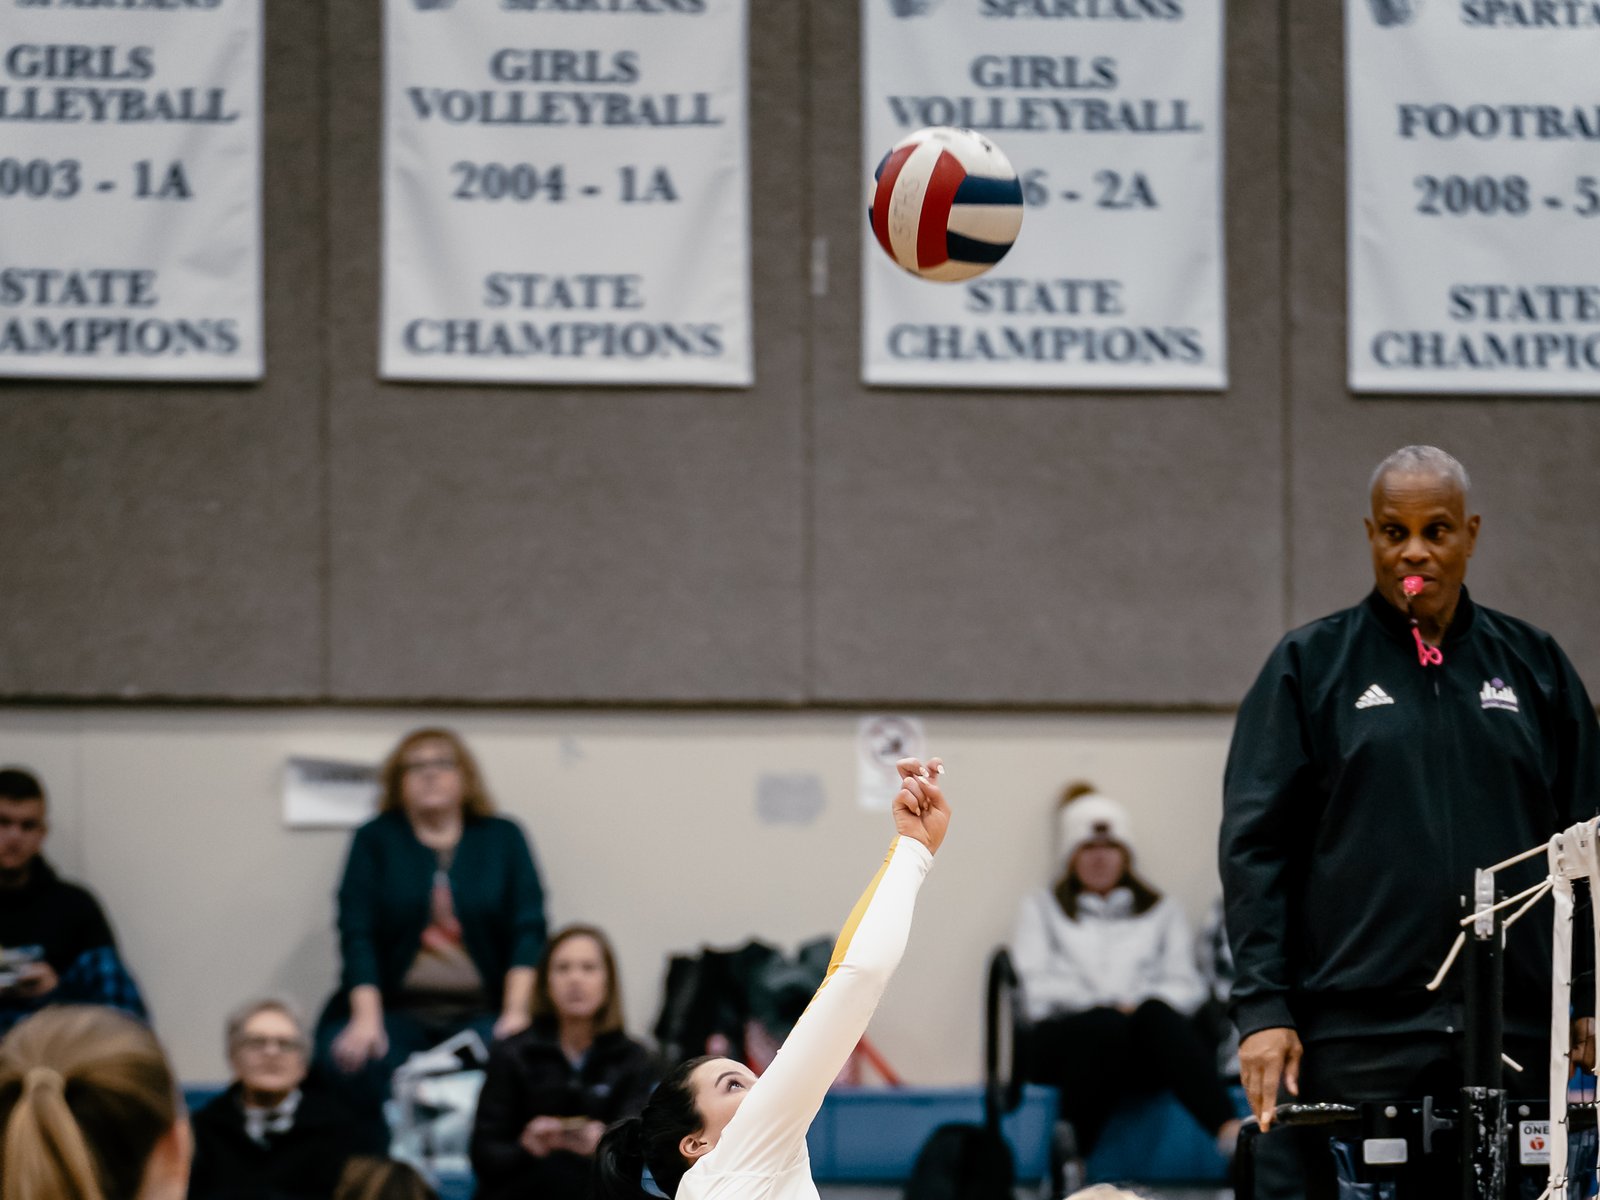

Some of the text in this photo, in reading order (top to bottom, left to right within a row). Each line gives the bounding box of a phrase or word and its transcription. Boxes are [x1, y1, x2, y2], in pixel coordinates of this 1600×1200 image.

[4, 44, 155, 80] GIRLS
[489, 48, 640, 84] GIRLS
[970, 54, 1118, 89] GIRLS
[405, 87, 725, 126] VOLLEYBALL
[886, 97, 1203, 132] VOLLEYBALL
[134, 159, 194, 199] 1A
[449, 160, 565, 204] 2004
[617, 164, 681, 204] 1A
[1094, 169, 1160, 210] 2A
[1413, 174, 1530, 216] 2008
[0, 268, 158, 307] STATE
[482, 272, 644, 309] STATE
[966, 278, 1124, 315] STATE
[1450, 284, 1600, 322] STATE
[402, 318, 725, 358] CHAMPIONS
[887, 323, 1205, 362] CHAMPIONS
